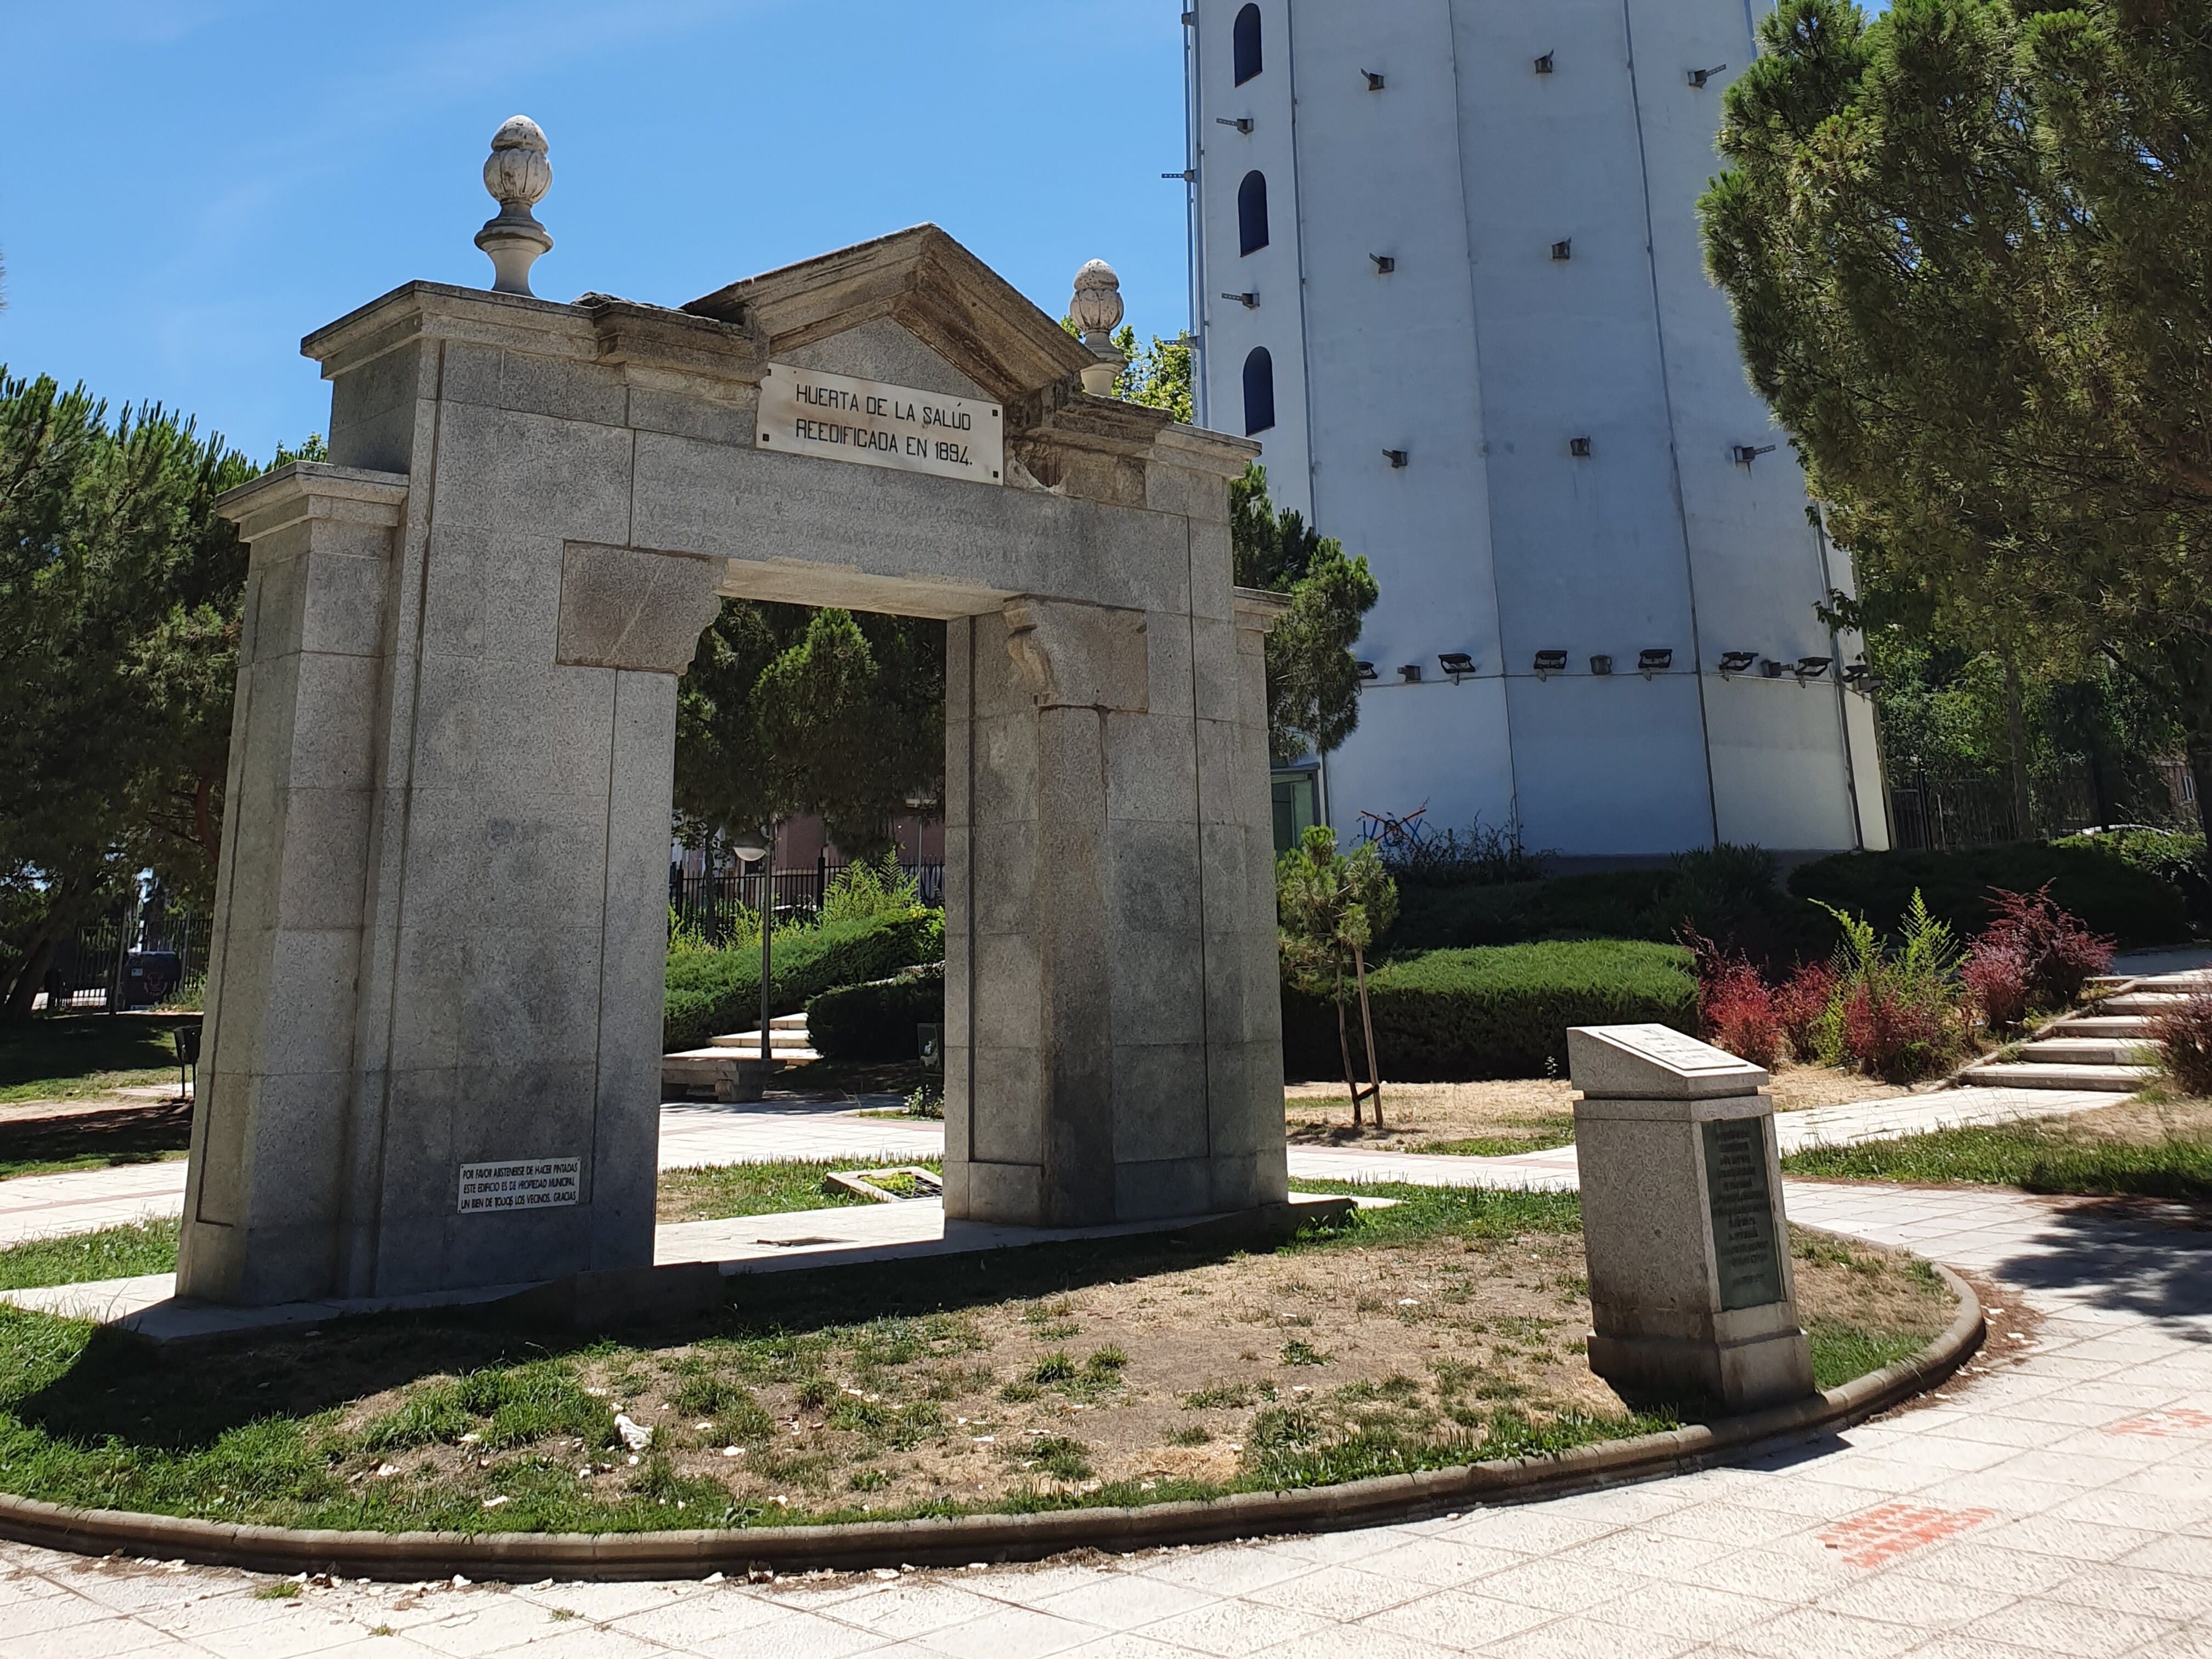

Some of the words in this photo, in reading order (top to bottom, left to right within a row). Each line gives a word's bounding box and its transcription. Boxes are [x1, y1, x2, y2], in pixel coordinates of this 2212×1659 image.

[797, 383, 859, 412] HUERTA
[866, 396, 888, 416] DE
[895, 401, 915, 421] LA
[923, 402, 970, 431] SALÚD
[796, 418, 898, 453] REEDIFICADA
[907, 436, 927, 458] EN
[935, 441, 973, 466] 1894.
[463, 1169, 474, 1179] POR
[475, 1168, 493, 1179] FAVOR
[493, 1166, 524, 1177] ABSTENERSE
[527, 1165, 533, 1175] DE
[535, 1164, 552, 1175] HACER
[554, 1162, 578, 1173] PINTADAS
[464, 1183, 476, 1194] ESTE
[478, 1182, 500, 1193] EDIFICIO
[501, 1181, 507, 1191] ES
[509, 1180, 516, 1190] DE
[518, 1178, 548, 1190] PROPIEDAD
[548, 1176, 575, 1187] MUNICIPAL
[461, 1199, 470, 1209] UN
[472, 1198, 483, 1209] BIEN
[486, 1197, 493, 1207] DE
[515, 1194, 525, 1205] LOS
[553, 1190, 576, 1202] GRACIAS
